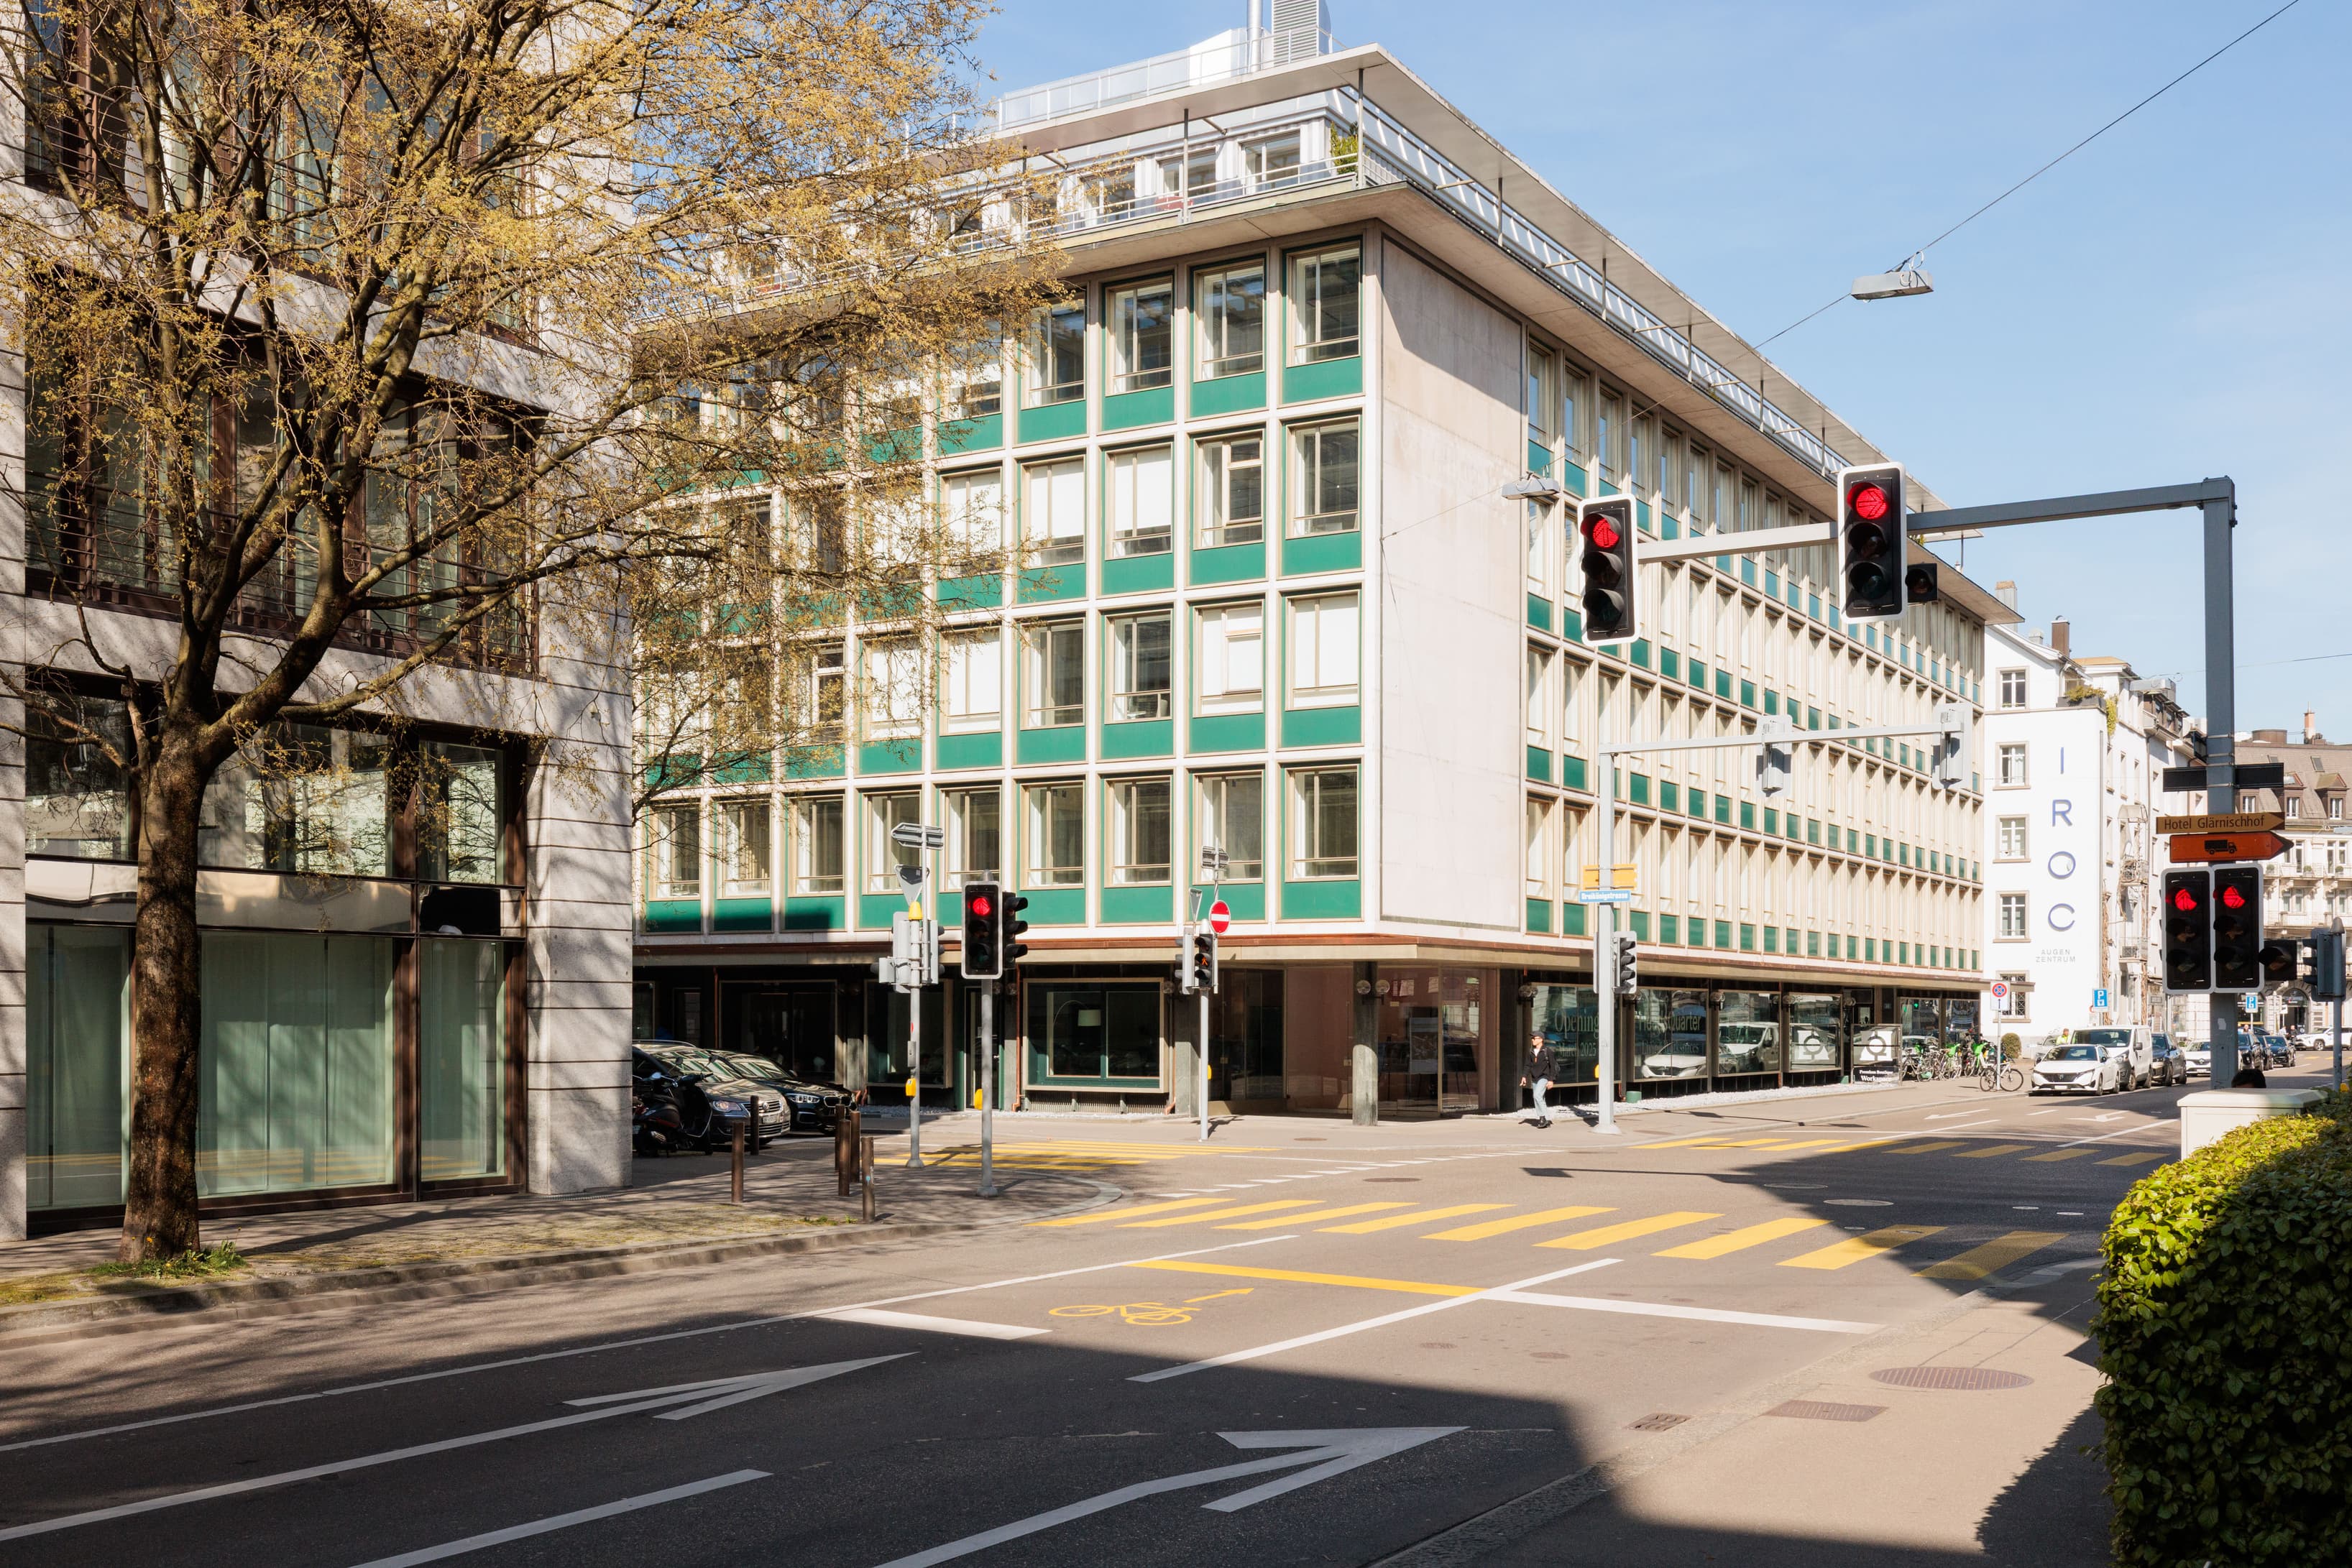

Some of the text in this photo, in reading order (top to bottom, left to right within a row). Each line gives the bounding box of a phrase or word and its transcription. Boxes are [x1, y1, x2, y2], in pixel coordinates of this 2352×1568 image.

[2164, 815, 2265, 830] Hotel Glärnischhof
[2048, 747, 2076, 932] IROC
[1555, 1009, 1599, 1039] Opening
[1581, 1042, 1597, 1057] 2025
